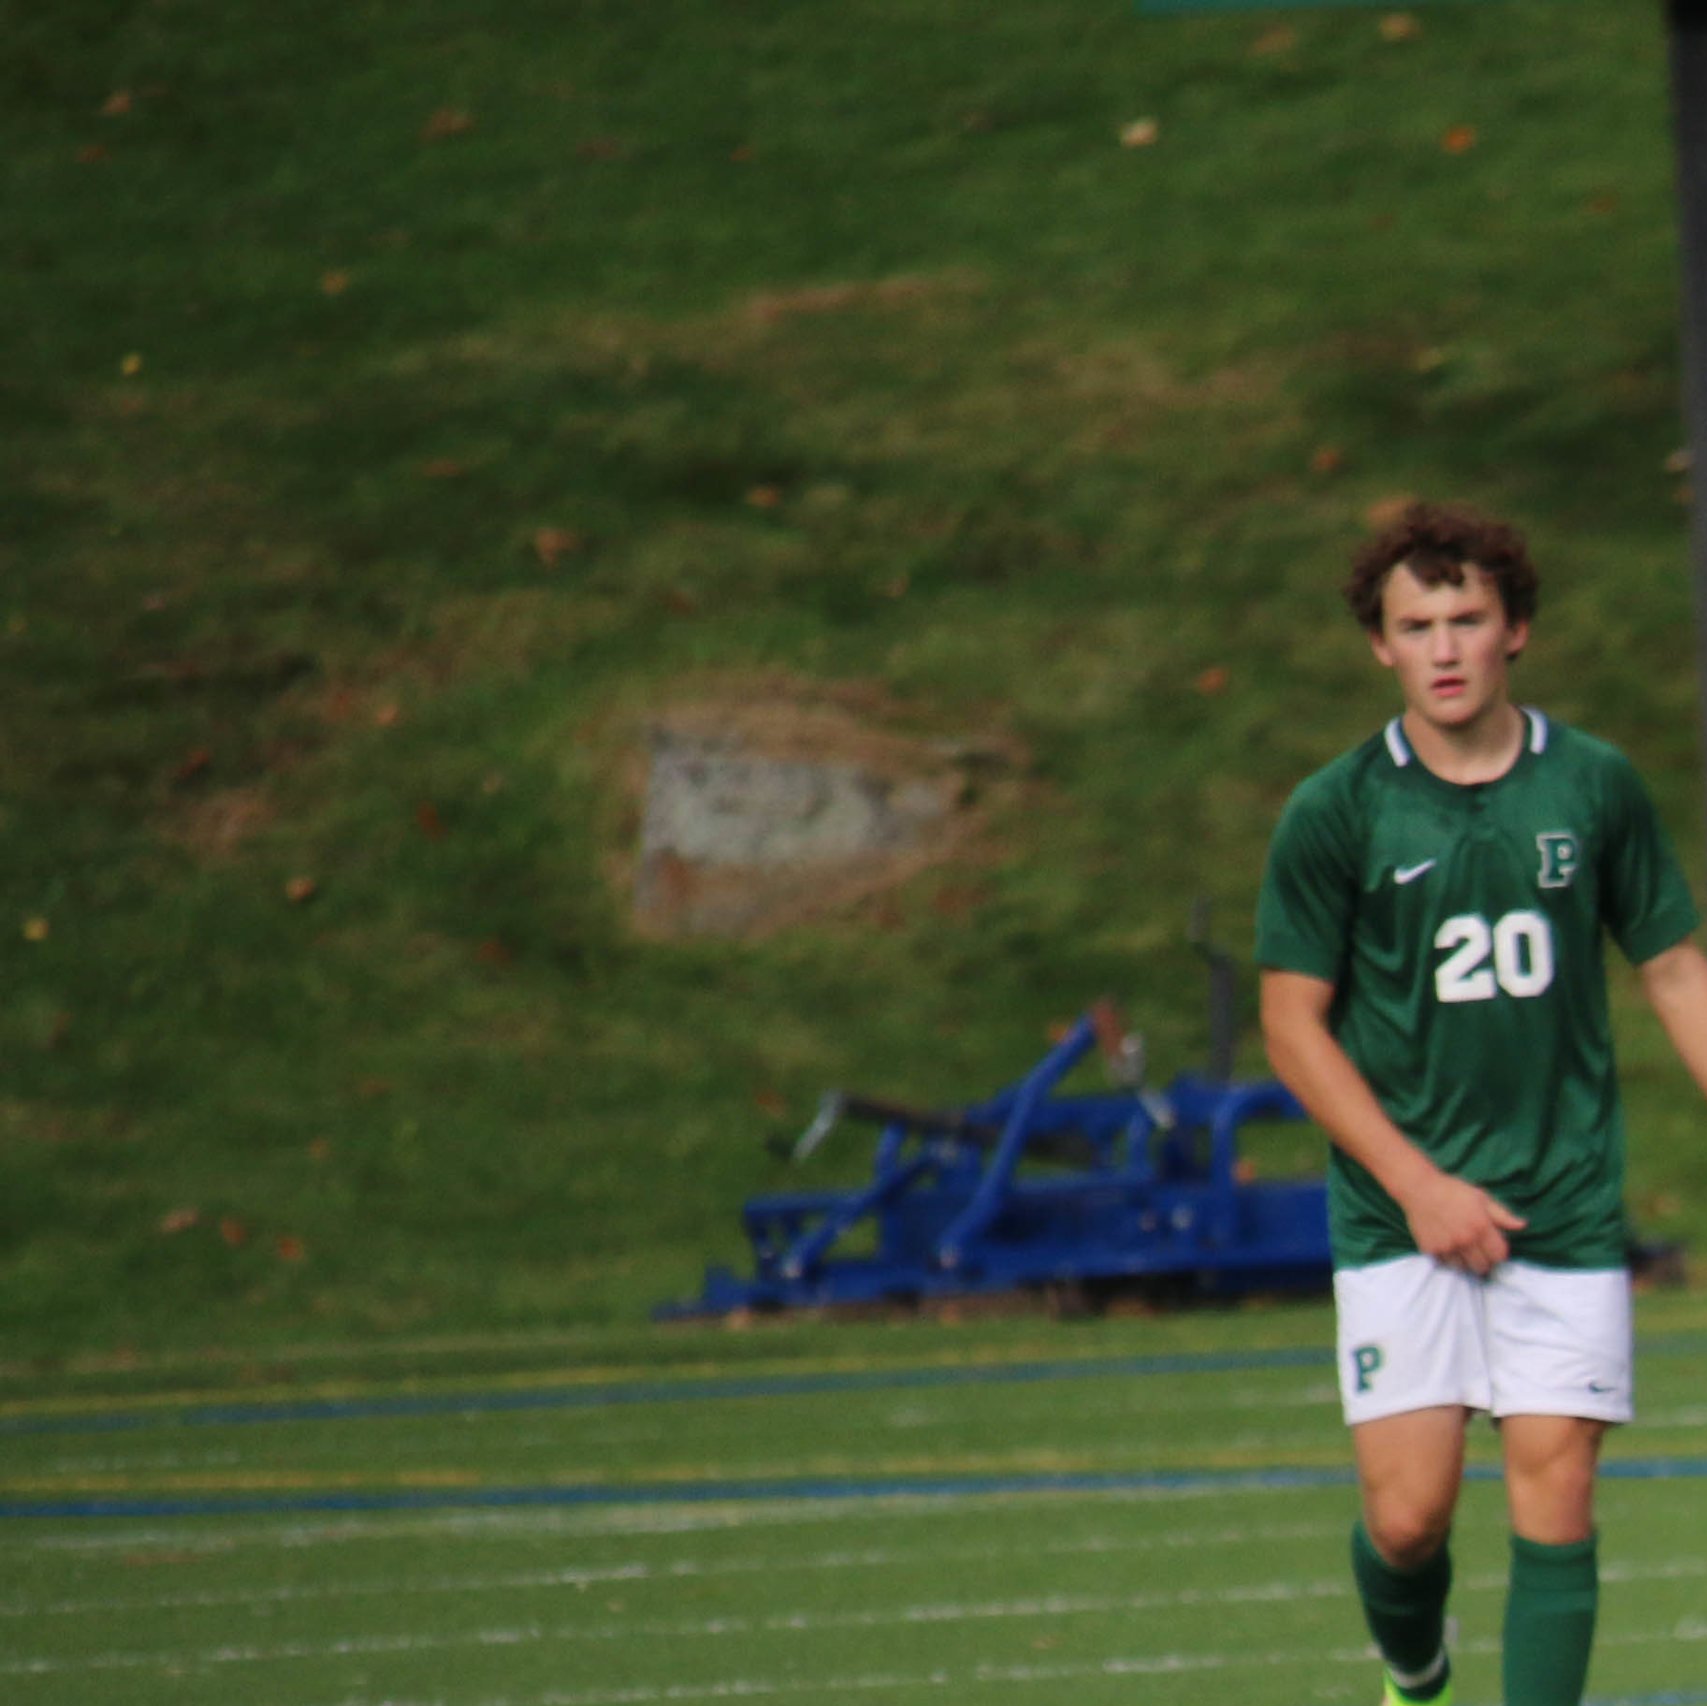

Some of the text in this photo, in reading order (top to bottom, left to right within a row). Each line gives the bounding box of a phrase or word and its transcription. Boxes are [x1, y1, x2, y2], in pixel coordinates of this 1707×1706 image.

[1536, 831, 1581, 889] P
[1434, 909, 1554, 1004] 20
[1353, 1345, 1384, 1393] P
